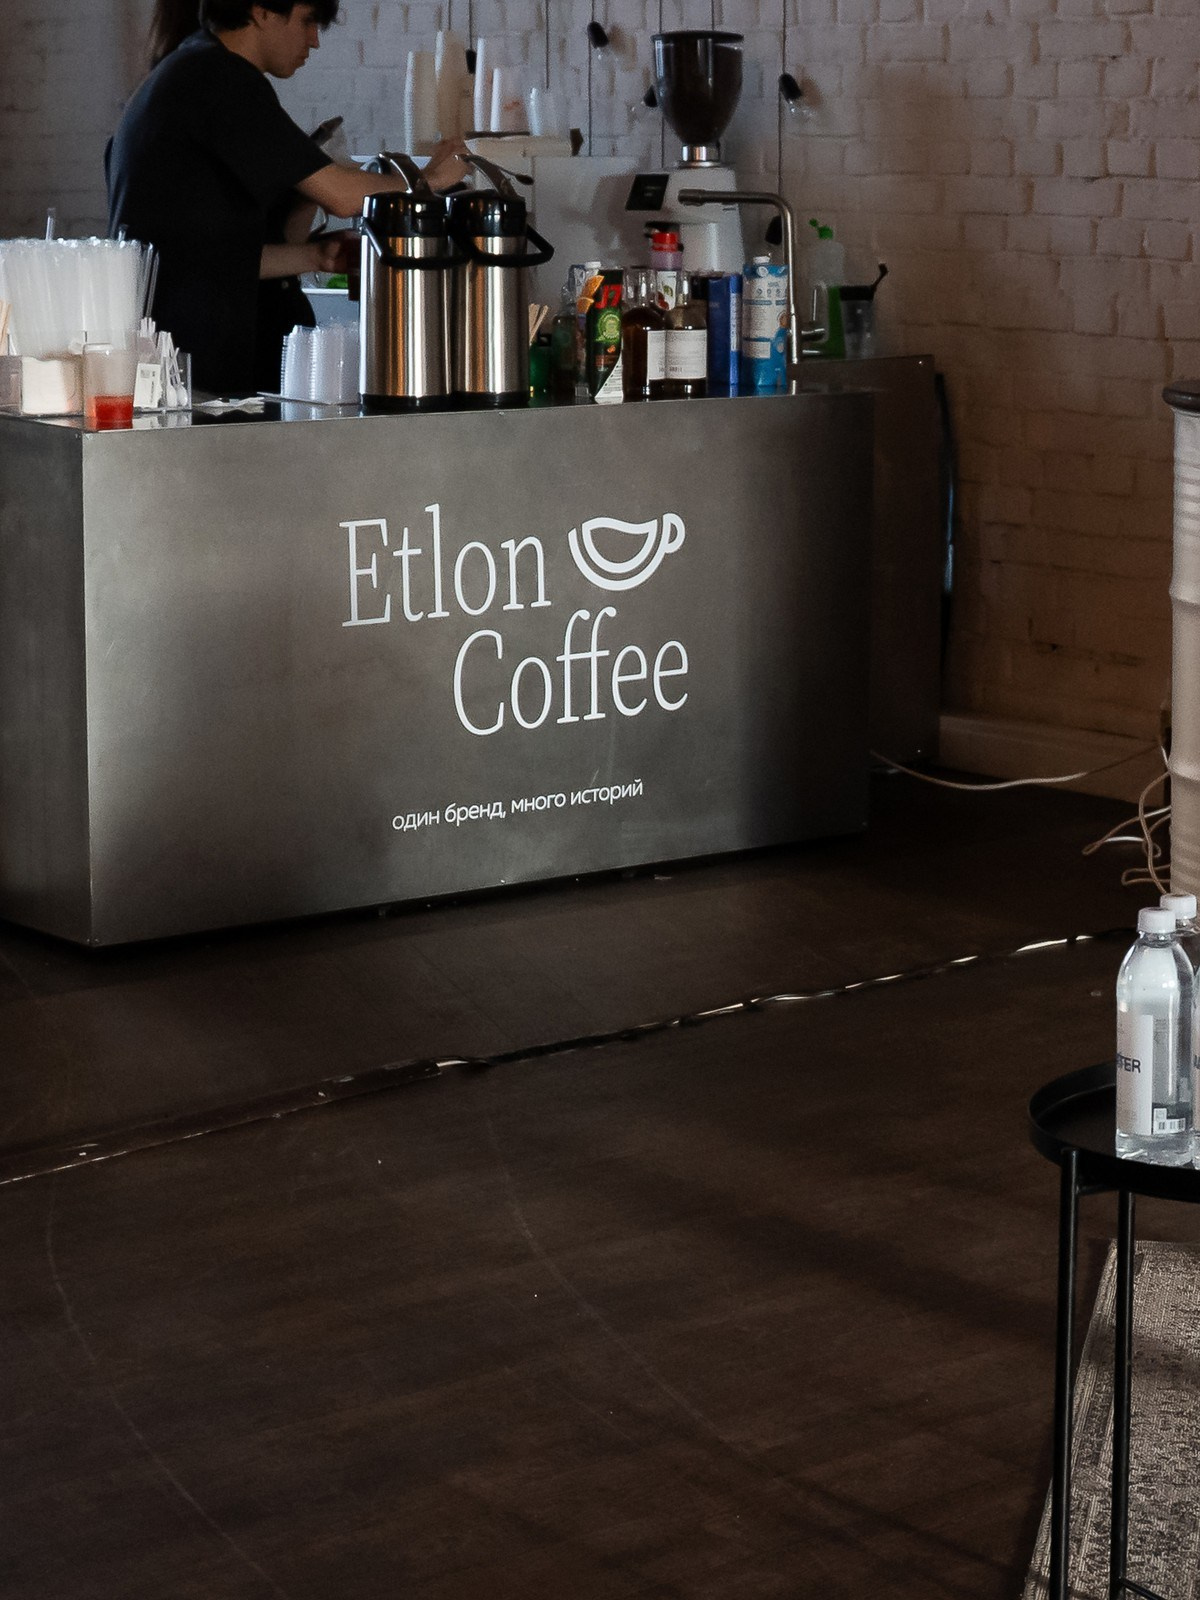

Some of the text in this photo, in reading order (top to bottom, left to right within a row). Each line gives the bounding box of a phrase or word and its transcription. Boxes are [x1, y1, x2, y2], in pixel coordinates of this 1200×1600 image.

[595, 284, 623, 309] J7
[339, 504, 552, 627] Etlon
[453, 606, 689, 736] Coffee
[392, 778, 644, 831] один бренд, много историй
